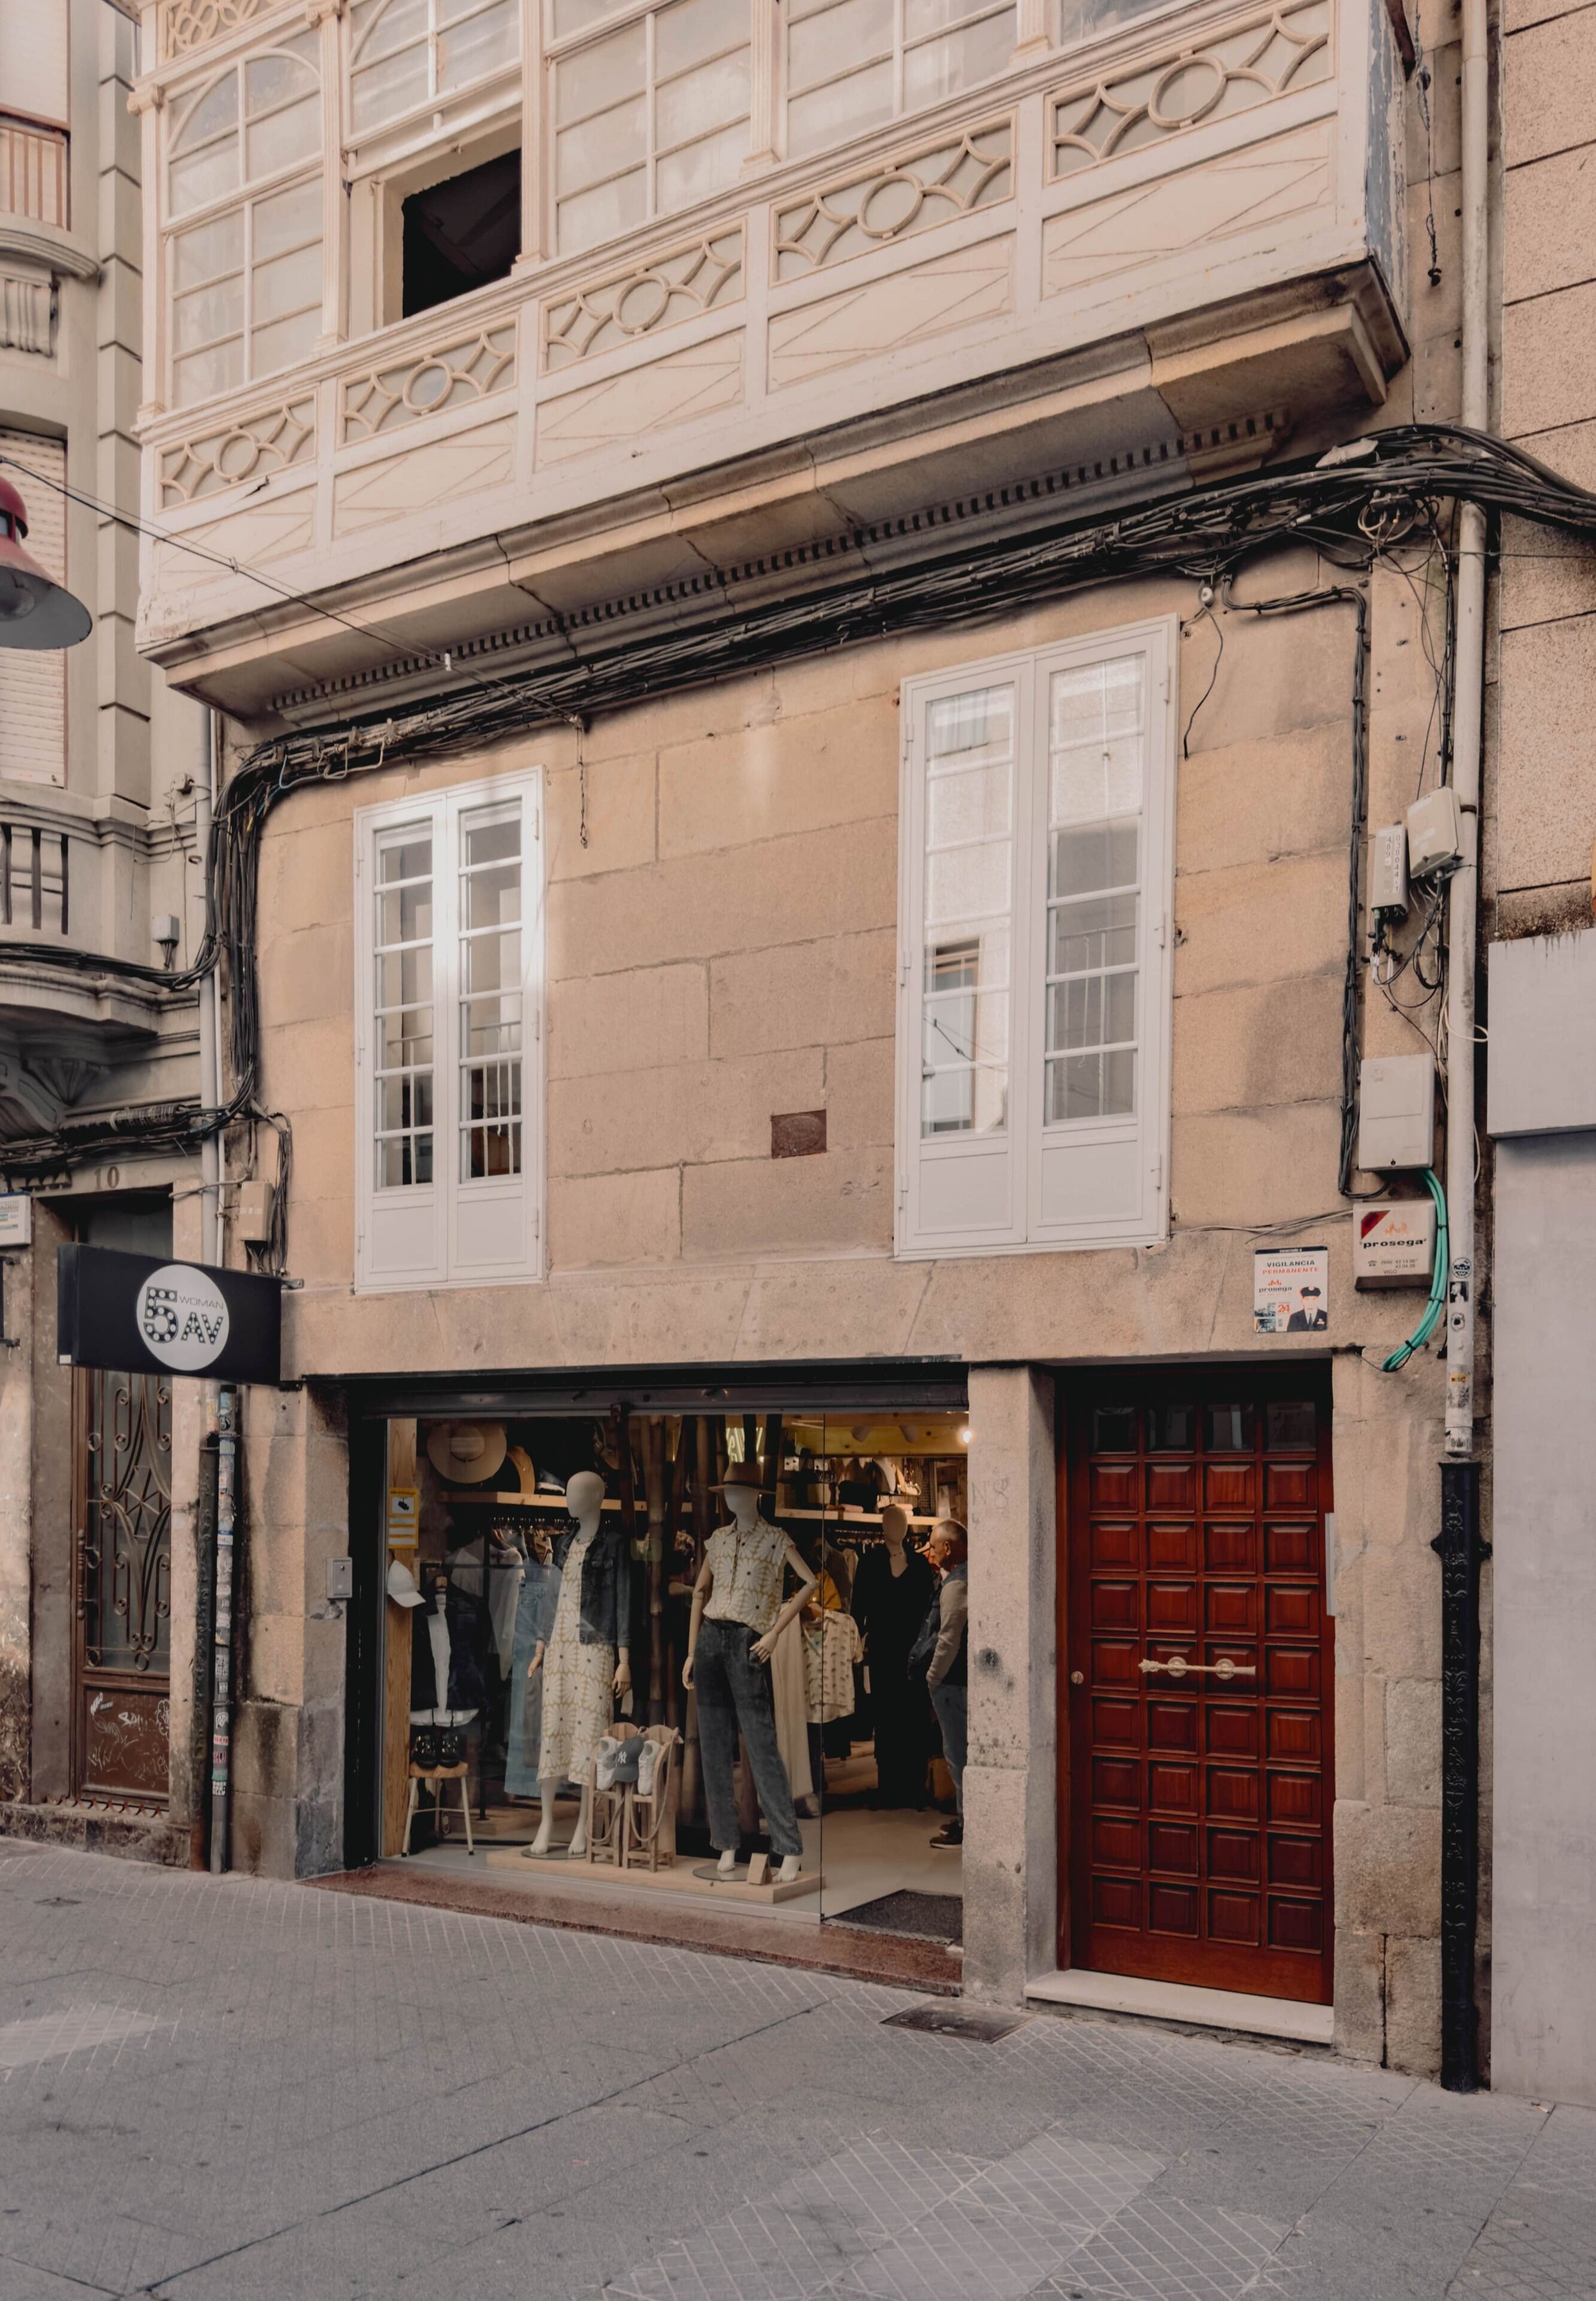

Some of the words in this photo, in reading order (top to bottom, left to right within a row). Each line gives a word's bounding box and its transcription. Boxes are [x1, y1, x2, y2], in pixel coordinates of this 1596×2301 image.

[94, 1165, 120, 1191] 10
[1364, 1239, 1423, 1249] prosega
[179, 1296, 223, 1309] WOMAN
[181, 1312, 223, 1345] AV
